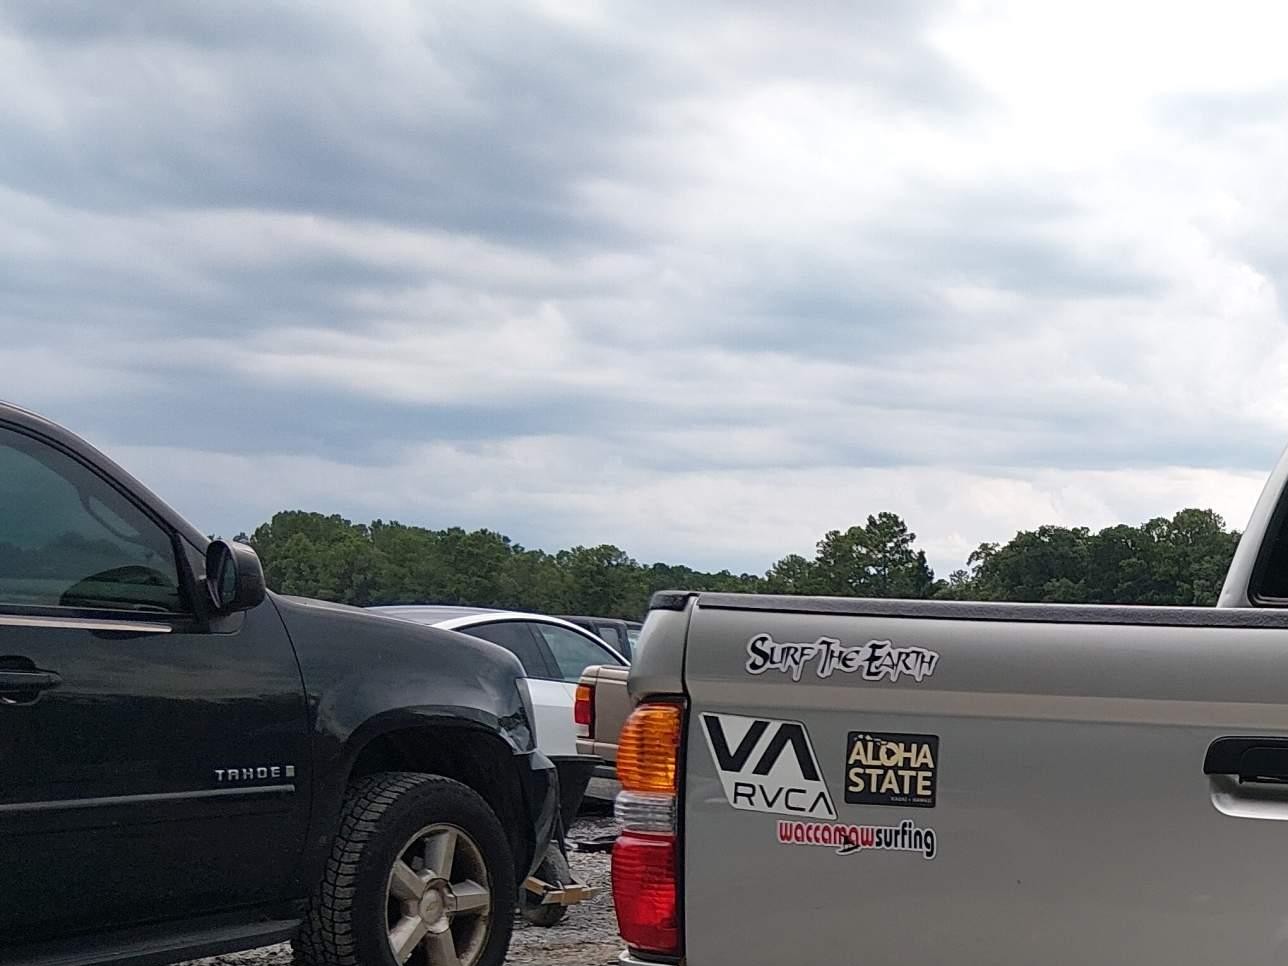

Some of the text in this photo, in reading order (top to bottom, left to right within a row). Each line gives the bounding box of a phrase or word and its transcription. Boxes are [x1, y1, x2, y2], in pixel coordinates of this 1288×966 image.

[750, 637, 936, 676] SURF THE EARTH
[848, 739, 935, 769] ALOHA
[214, 766, 281, 782] TAHOE
[848, 769, 933, 796] STATE
[733, 782, 834, 815] RVCA
